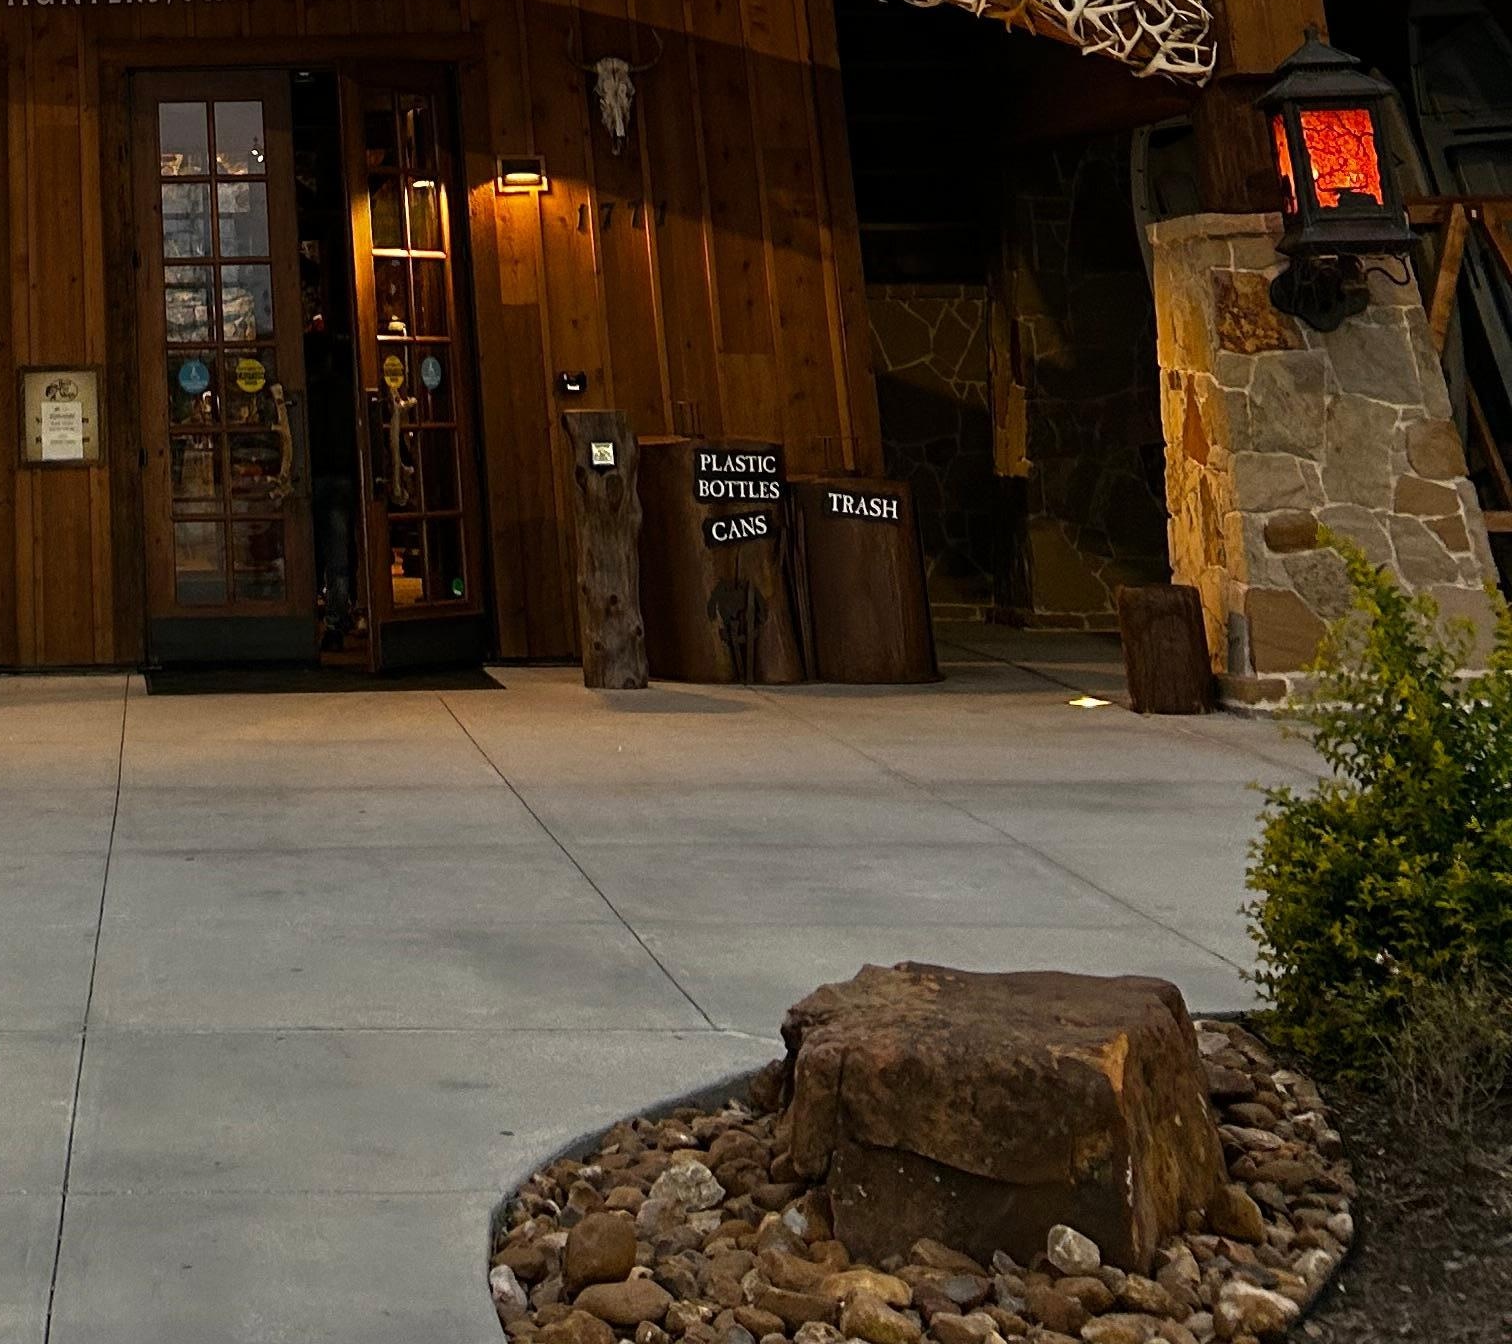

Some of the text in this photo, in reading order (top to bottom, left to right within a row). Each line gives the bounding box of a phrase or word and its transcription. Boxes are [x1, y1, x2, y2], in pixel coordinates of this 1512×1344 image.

[700, 454, 777, 474] PLASTIC
[698, 479, 781, 500] BOTTLES
[828, 492, 899, 520] TRASH
[711, 515, 768, 542] CANS
